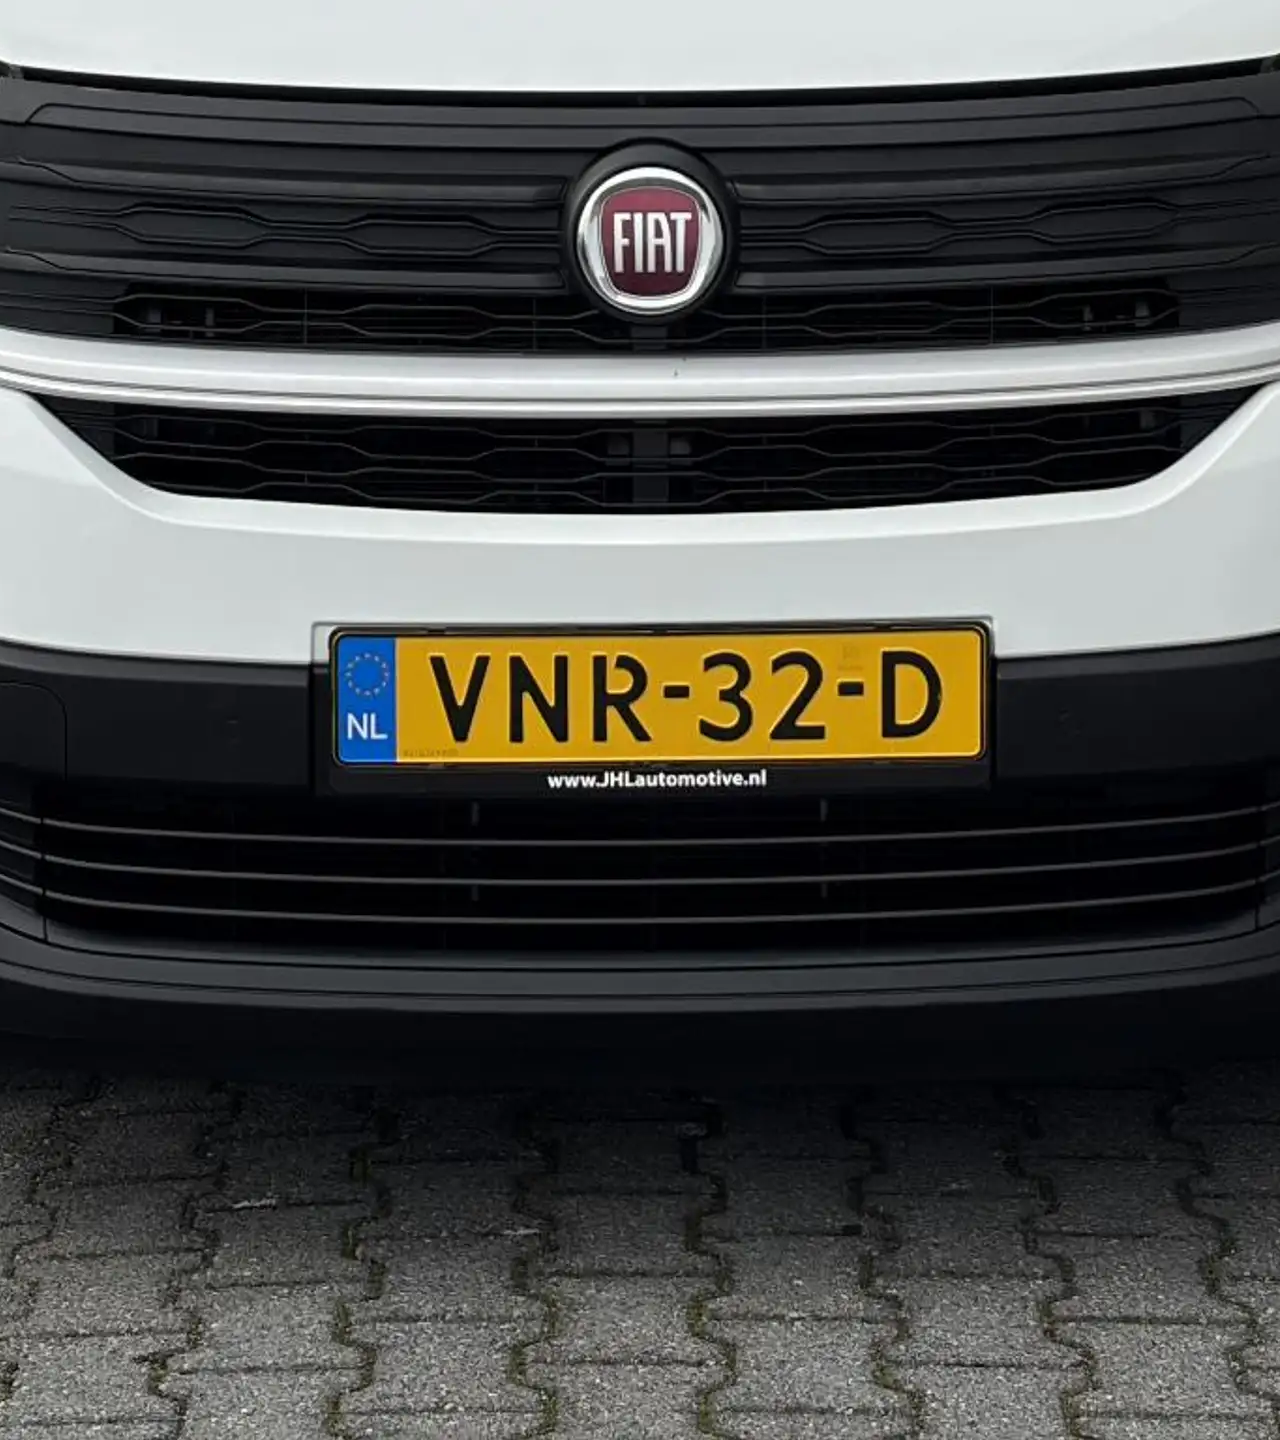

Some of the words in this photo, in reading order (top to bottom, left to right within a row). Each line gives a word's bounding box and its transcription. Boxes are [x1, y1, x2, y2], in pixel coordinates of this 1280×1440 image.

[613, 212, 692, 274] FIAT
[429, 648, 943, 744] VNR-32-D
[346, 711, 388, 740] NL
[547, 769, 768, 789] www.JHLautomotive.nl
